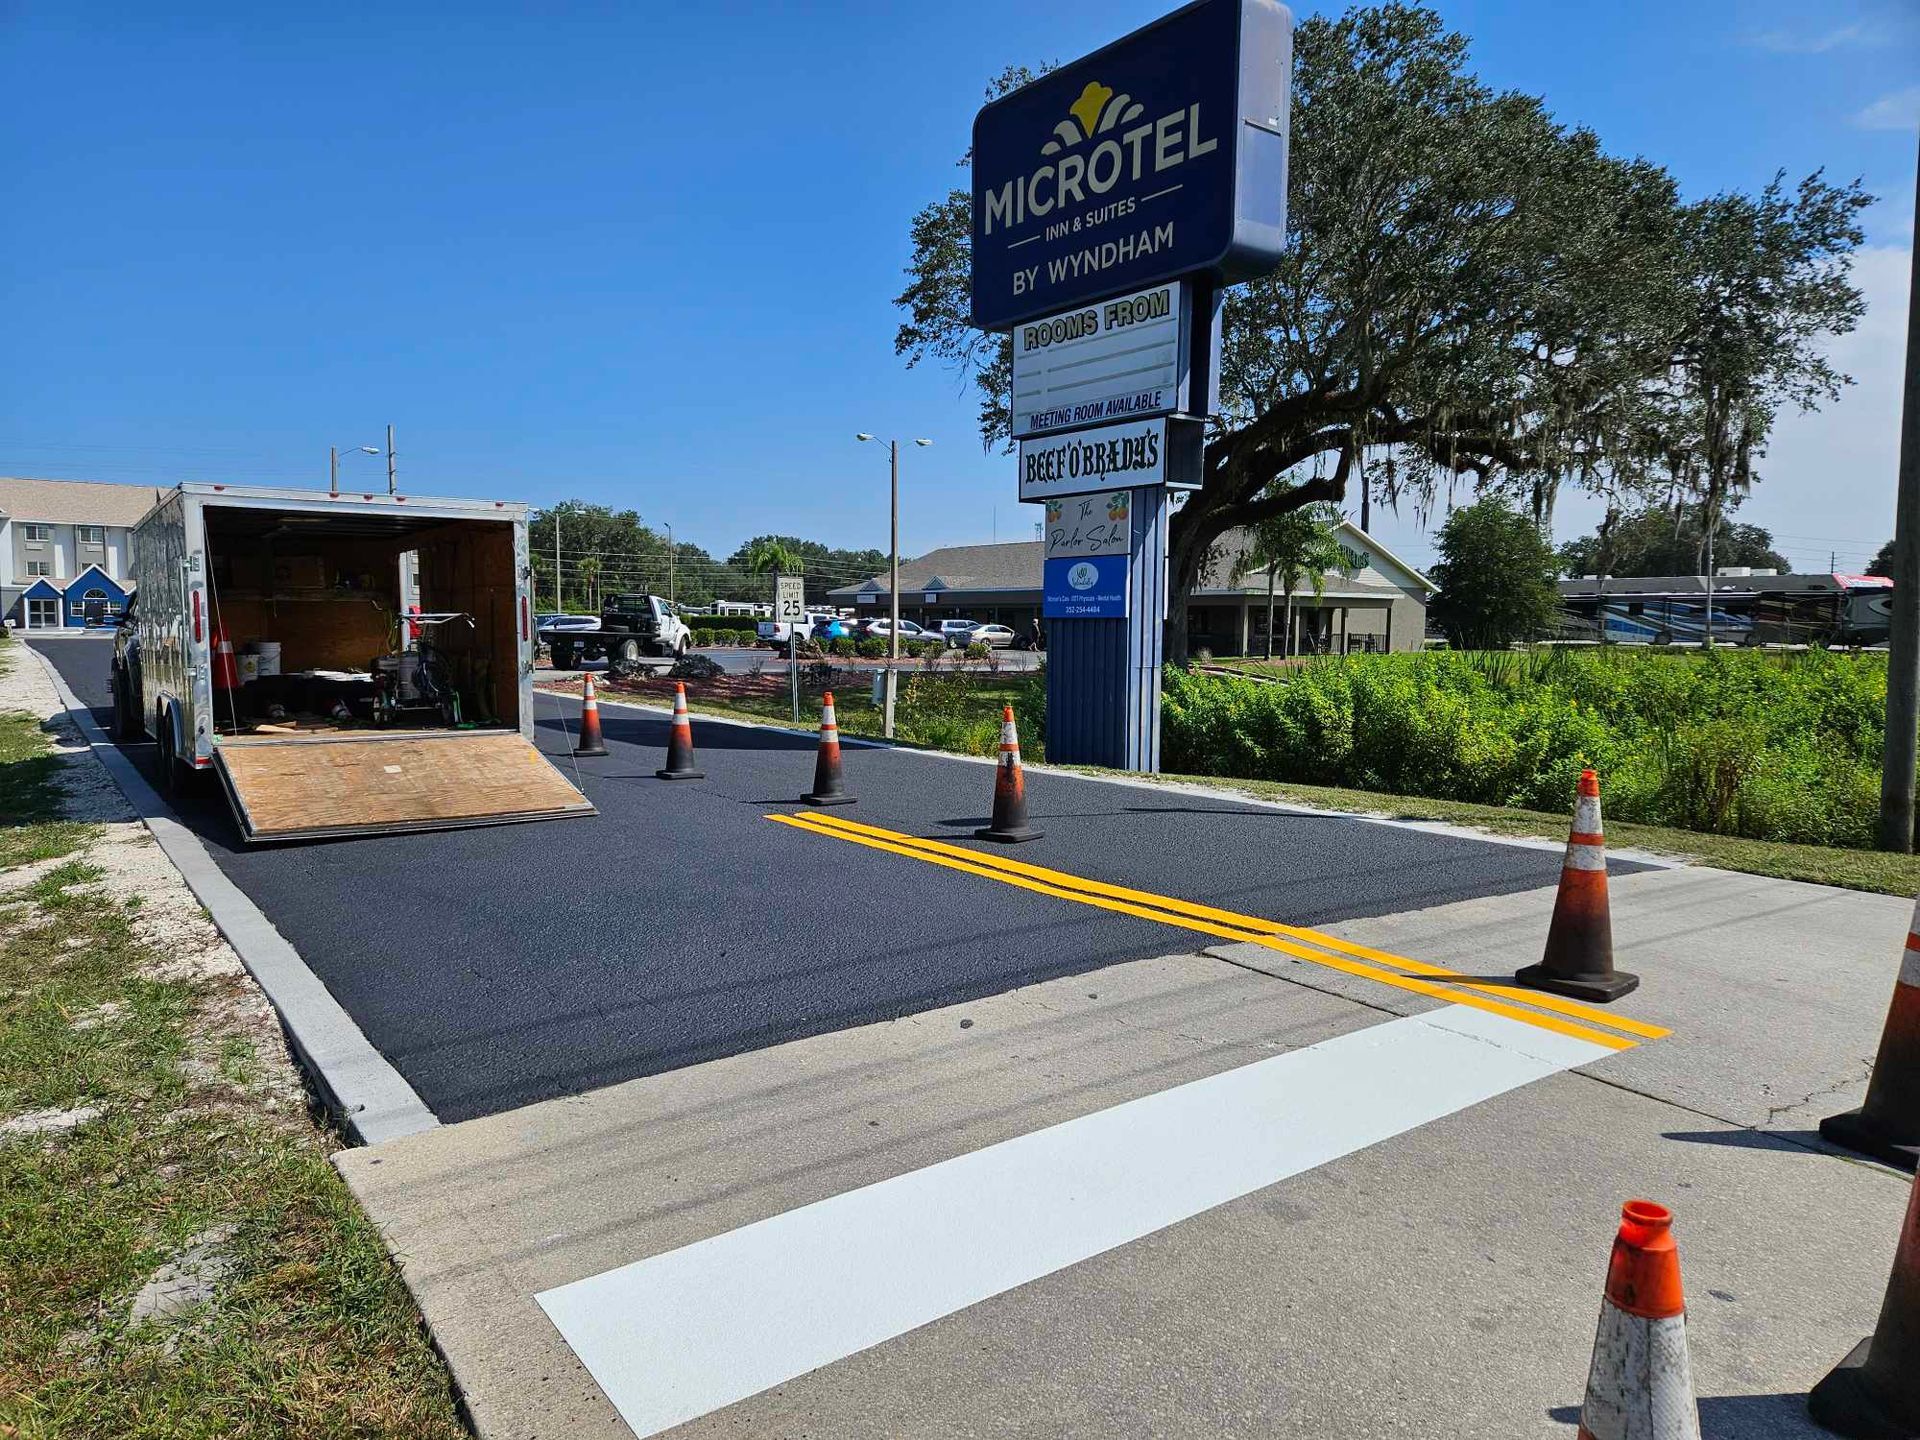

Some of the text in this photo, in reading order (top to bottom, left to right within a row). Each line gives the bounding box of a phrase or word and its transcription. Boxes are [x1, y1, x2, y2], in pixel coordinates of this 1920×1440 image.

[984, 102, 1218, 236] MICROTEL
[1045, 196, 1136, 242] INN & SUITES
[1013, 221, 1174, 296] BY WYNDHAM
[1023, 289, 1170, 351] ROOMS FROM
[1030, 390, 1162, 430] MEETING ROOM AVAILABLE
[1078, 499, 1093, 520] The
[1050, 524, 1125, 552] Parlor Salon
[780, 582, 801, 590] SPEED
[782, 591, 799, 599] LIMIT
[783, 600, 800, 616] 25
